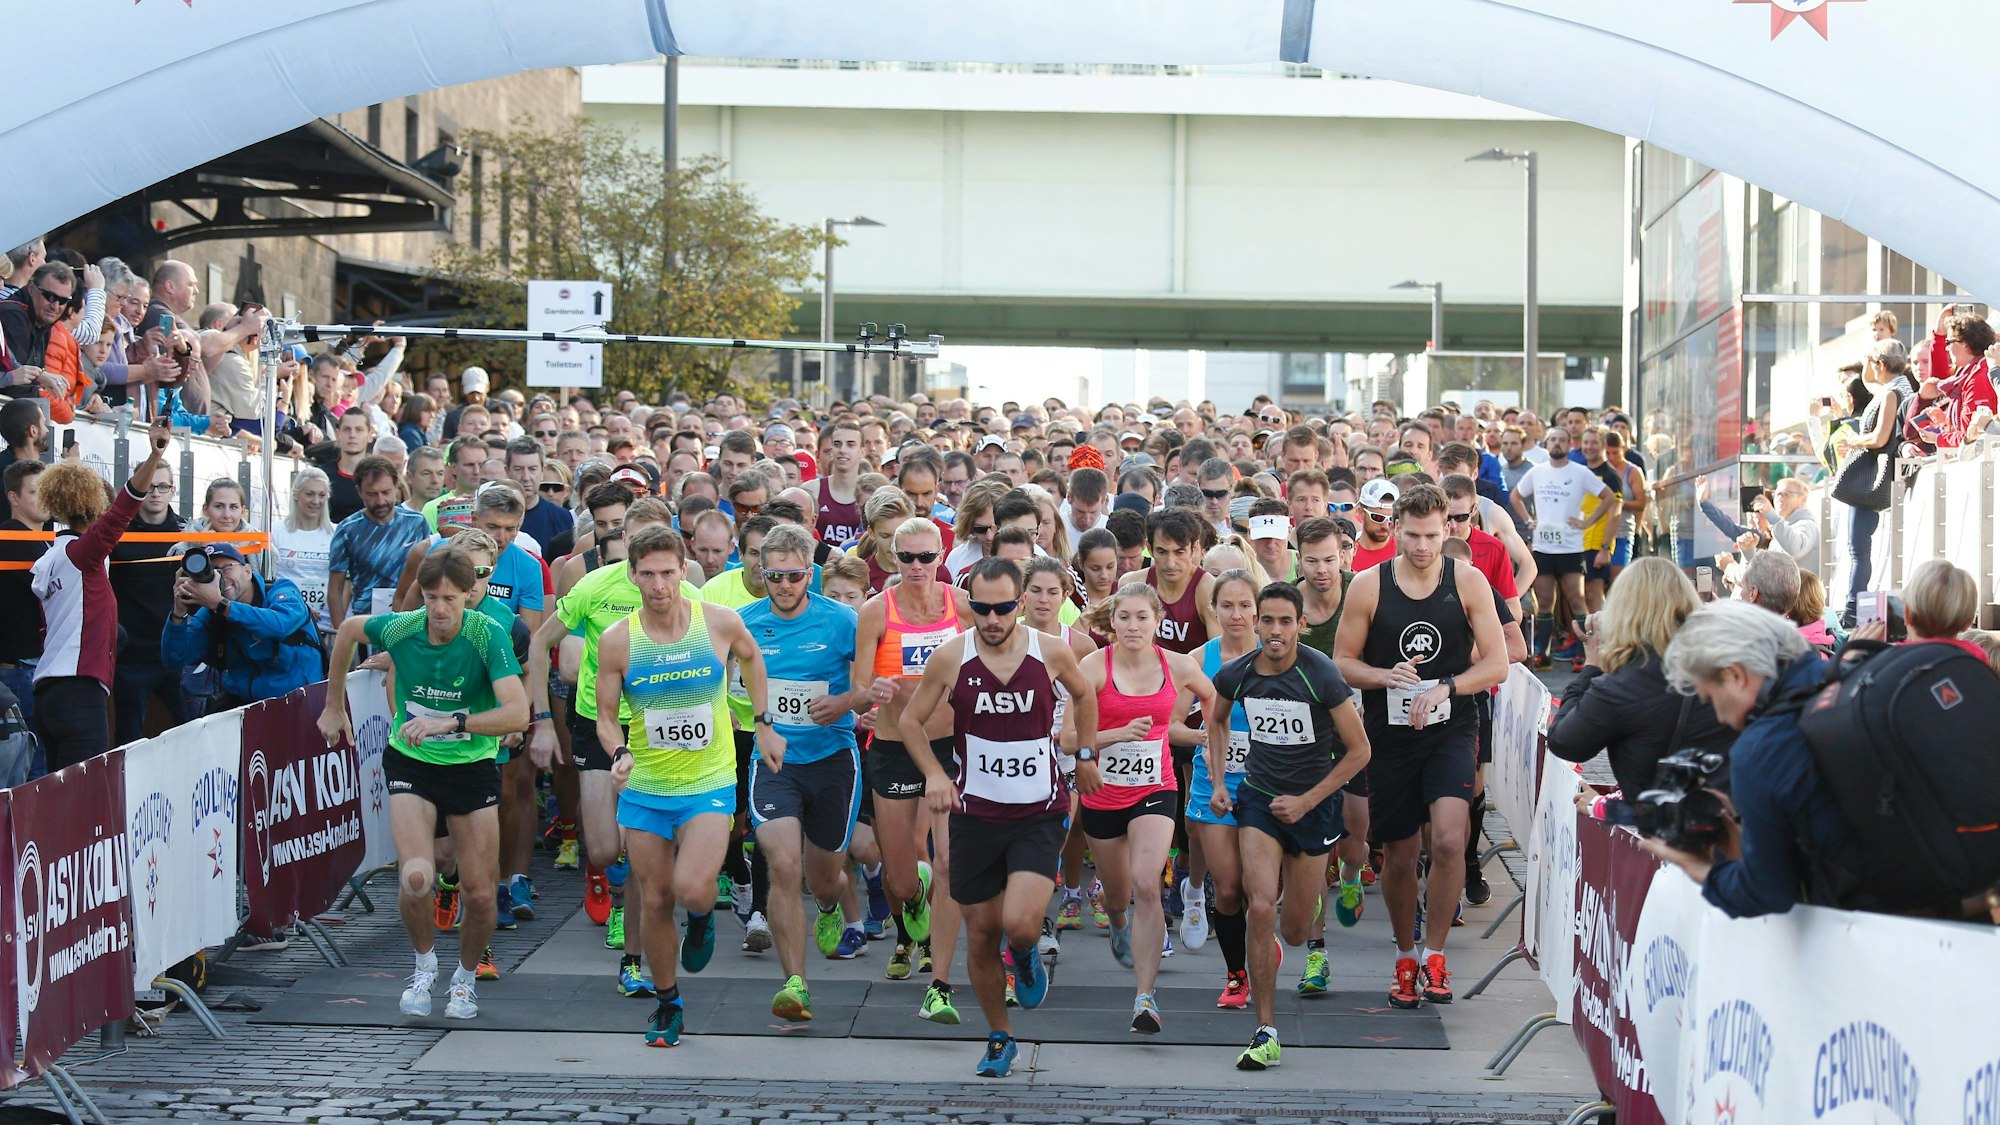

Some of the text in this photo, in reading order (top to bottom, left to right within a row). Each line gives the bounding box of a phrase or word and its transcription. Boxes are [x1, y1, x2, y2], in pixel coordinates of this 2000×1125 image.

[544, 307, 585, 315] Garderobe
[545, 360, 583, 368] Toiletten
[823, 524, 859, 542] ASV
[1539, 531, 1562, 541] 1615
[611, 603, 635, 612] bunert
[665, 650, 691, 662] bunert
[909, 646, 942, 666] 42
[648, 666, 712, 684] BROOKS
[427, 686, 463, 699] bunert
[974, 689, 1035, 715] ASV
[777, 696, 813, 715] 891
[655, 722, 706, 741] 1560
[1254, 715, 1304, 735] 2210
[978, 754, 1038, 778] 1436
[1105, 756, 1155, 775] 2249
[269, 759, 307, 826] ASV
[45, 825, 128, 933] ASV KÖLN
